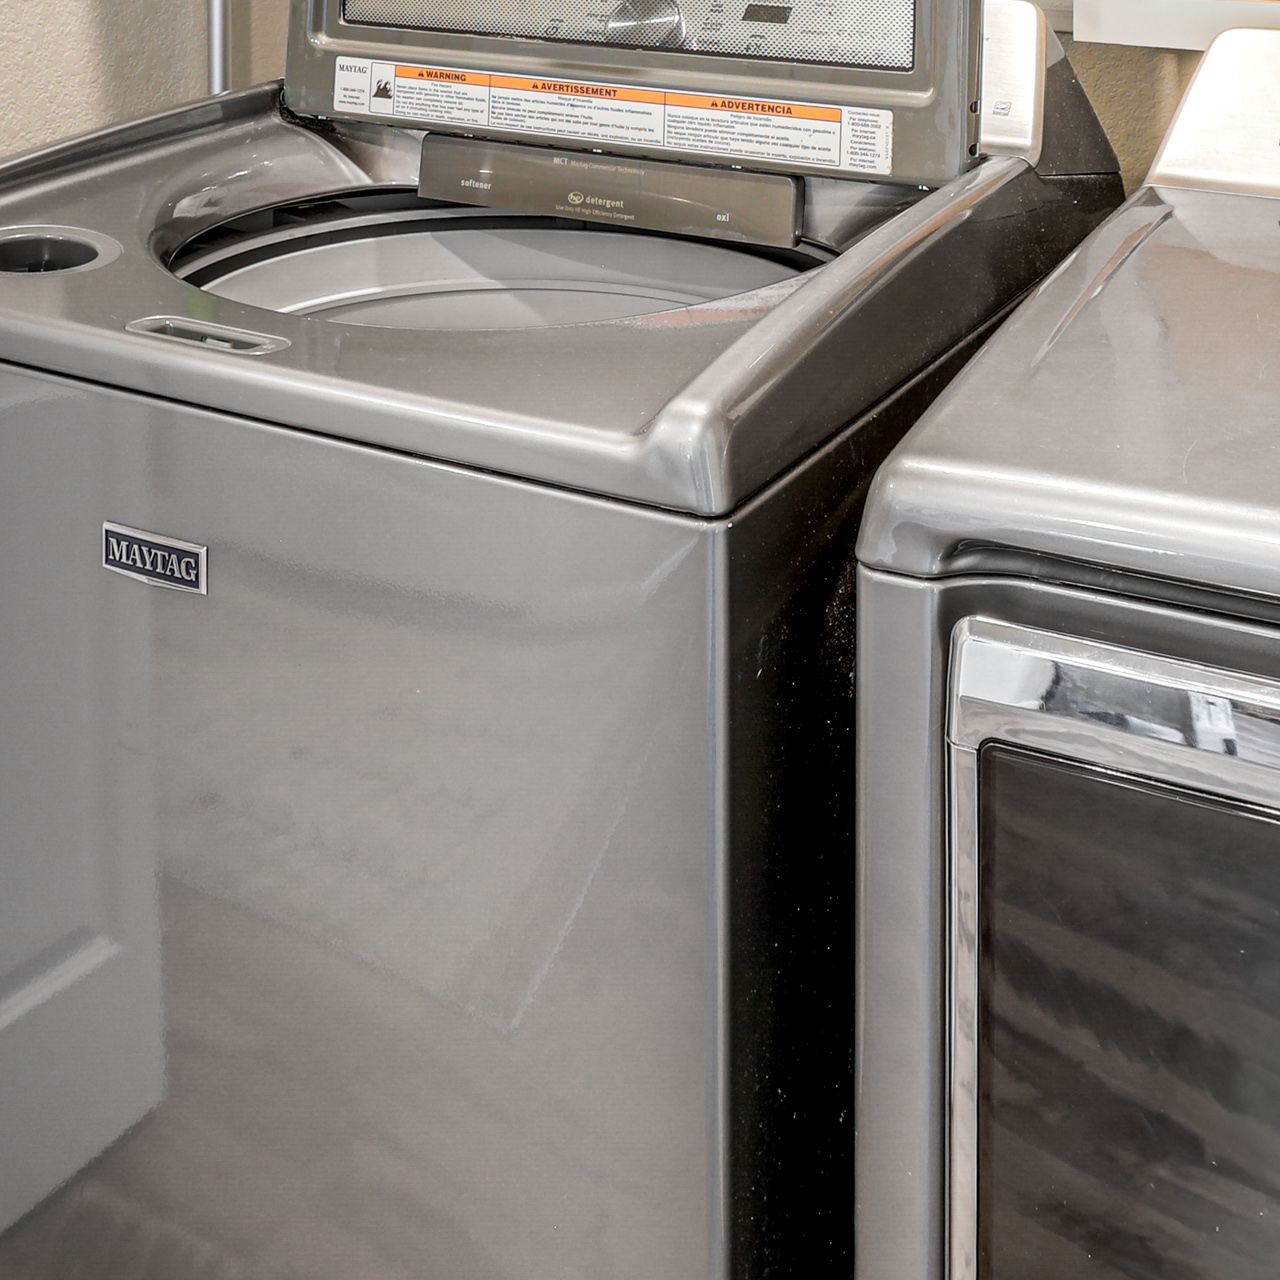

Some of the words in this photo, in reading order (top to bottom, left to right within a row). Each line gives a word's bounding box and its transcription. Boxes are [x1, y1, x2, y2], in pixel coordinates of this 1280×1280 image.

[338, 63, 367, 74] MAYTAG
[426, 71, 466, 82] WARNING
[541, 82, 618, 97] AVERTISSEMENT
[720, 100, 792, 115] ADVERTENCIA
[553, 157, 569, 166] MCT
[460, 178, 492, 190] softener
[585, 196, 624, 209] detergent
[716, 213, 730, 222] oxi
[108, 537, 198, 582] MAYTAG
